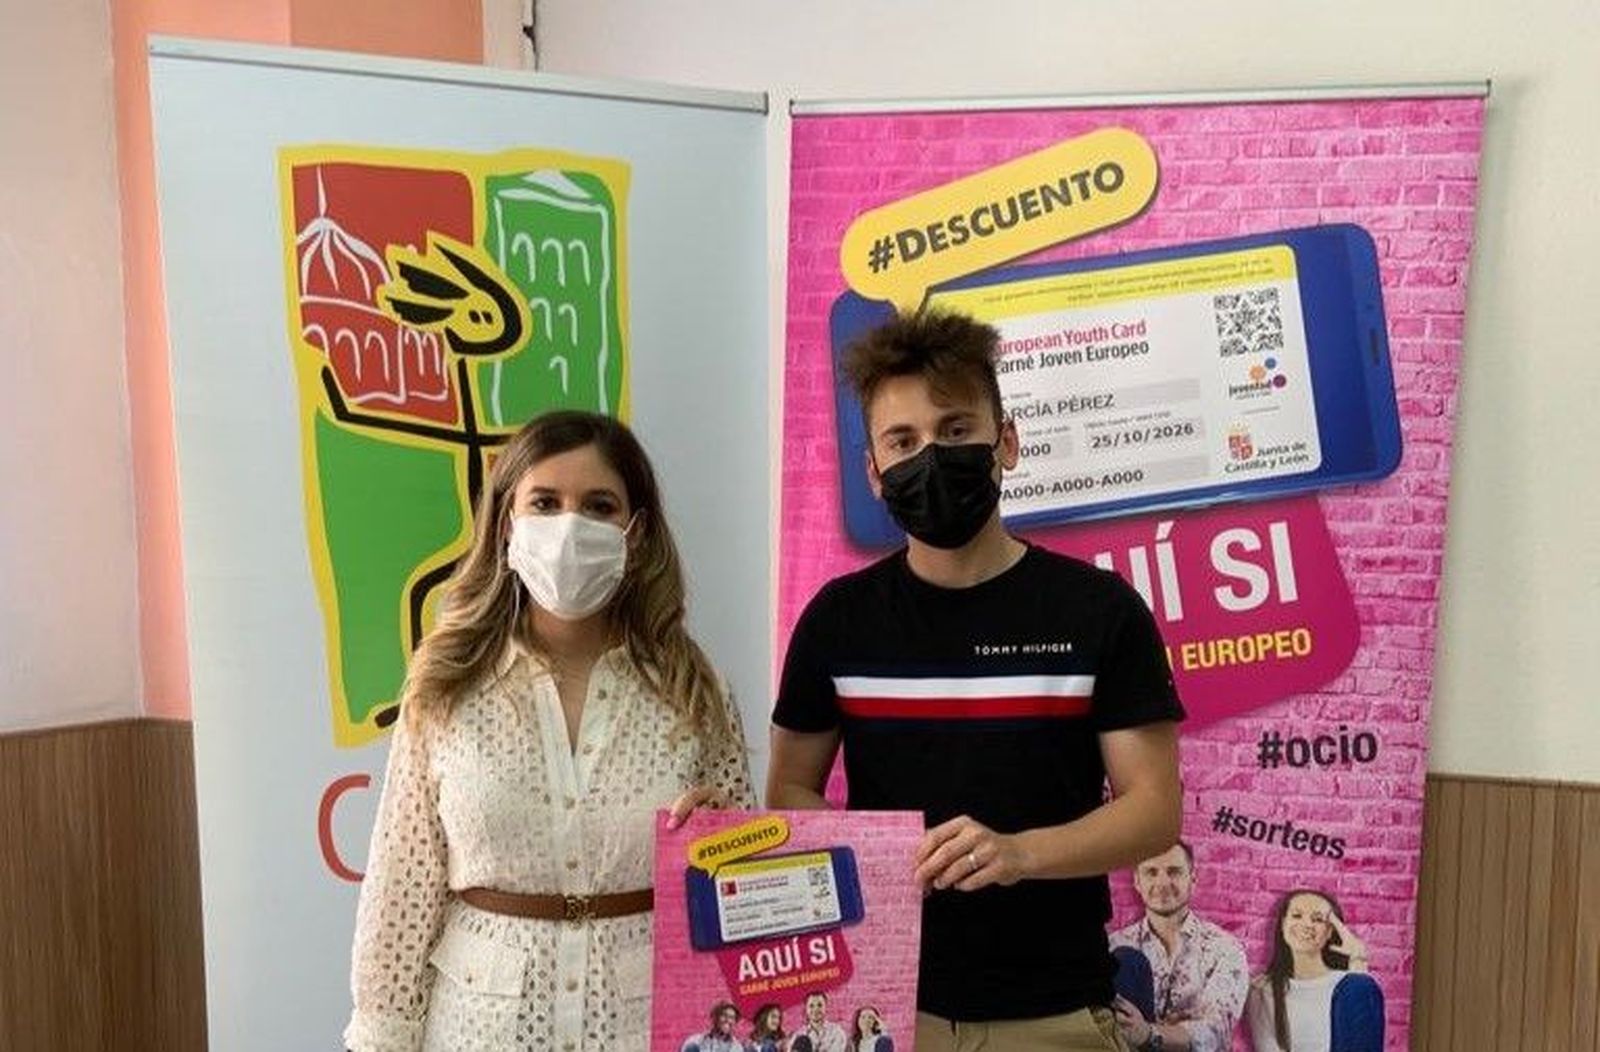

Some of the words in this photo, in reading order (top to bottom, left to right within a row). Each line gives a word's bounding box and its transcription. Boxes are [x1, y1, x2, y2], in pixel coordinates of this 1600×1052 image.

[868, 161, 1125, 273] #DESCUENTO
[994, 335, 1063, 356] uropean
[1064, 327, 1109, 345] Youth
[1111, 320, 1147, 339] Card
[1039, 352, 1082, 369] Joven
[1086, 341, 1150, 361] Europeo
[1001, 400, 1053, 423] ARCÍA
[1058, 394, 1115, 414] PÉREZ
[1020, 442, 1051, 458] 000
[1092, 423, 1194, 449] 25/10/2026
[1000, 469, 1144, 501] A000-A000-A000
[1209, 521, 1299, 612] SI
[974, 645, 1018, 656] TOMMY
[1022, 642, 1073, 654] HILFIGER
[1181, 628, 1312, 671] EUROPEO
[1256, 726, 1378, 769] #ocio
[1212, 806, 1346, 860] #sorteos
[738, 936, 802, 982] AQUÍ
[809, 935, 836, 964] SI
